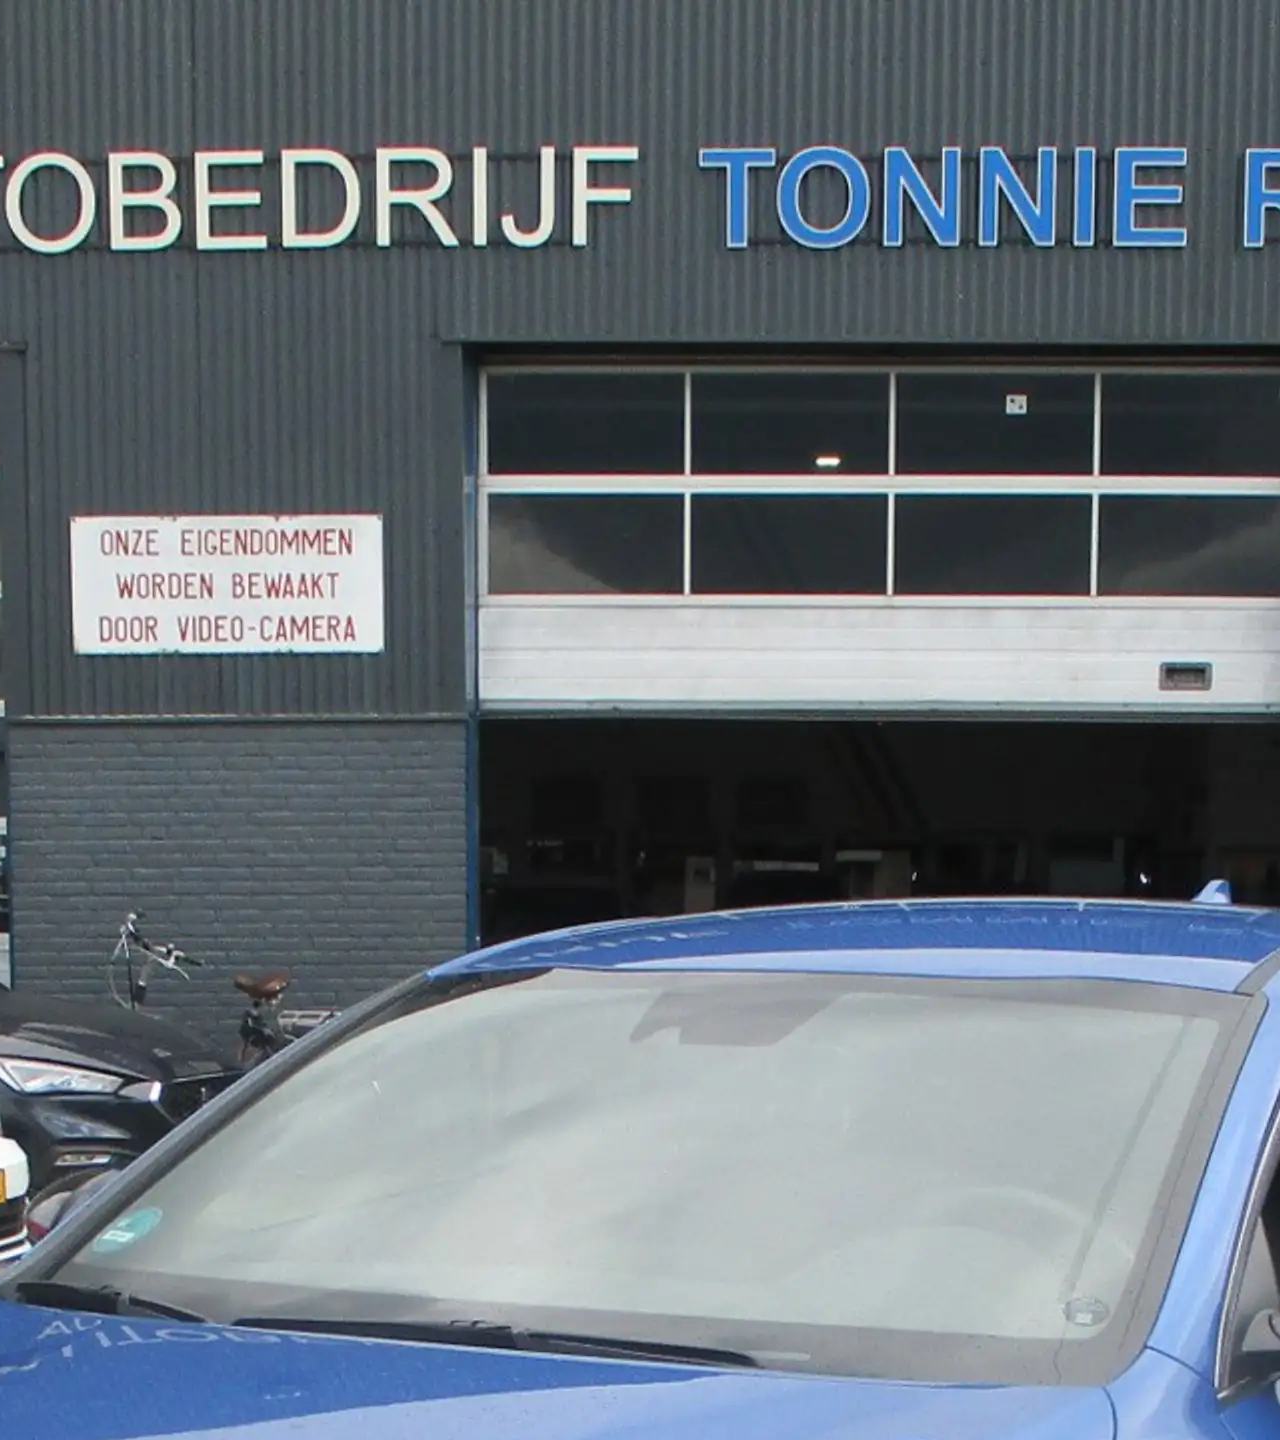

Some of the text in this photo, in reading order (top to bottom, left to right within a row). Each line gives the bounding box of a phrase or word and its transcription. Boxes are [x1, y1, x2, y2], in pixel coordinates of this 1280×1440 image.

[699, 146, 1187, 250] TONNIE
[100, 528, 353, 556] ONZE EIGENDOMMEN
[116, 572, 339, 599] WORDEN BEWAAKT
[99, 615, 356, 642] DOOR VIDEO-CAMERA
